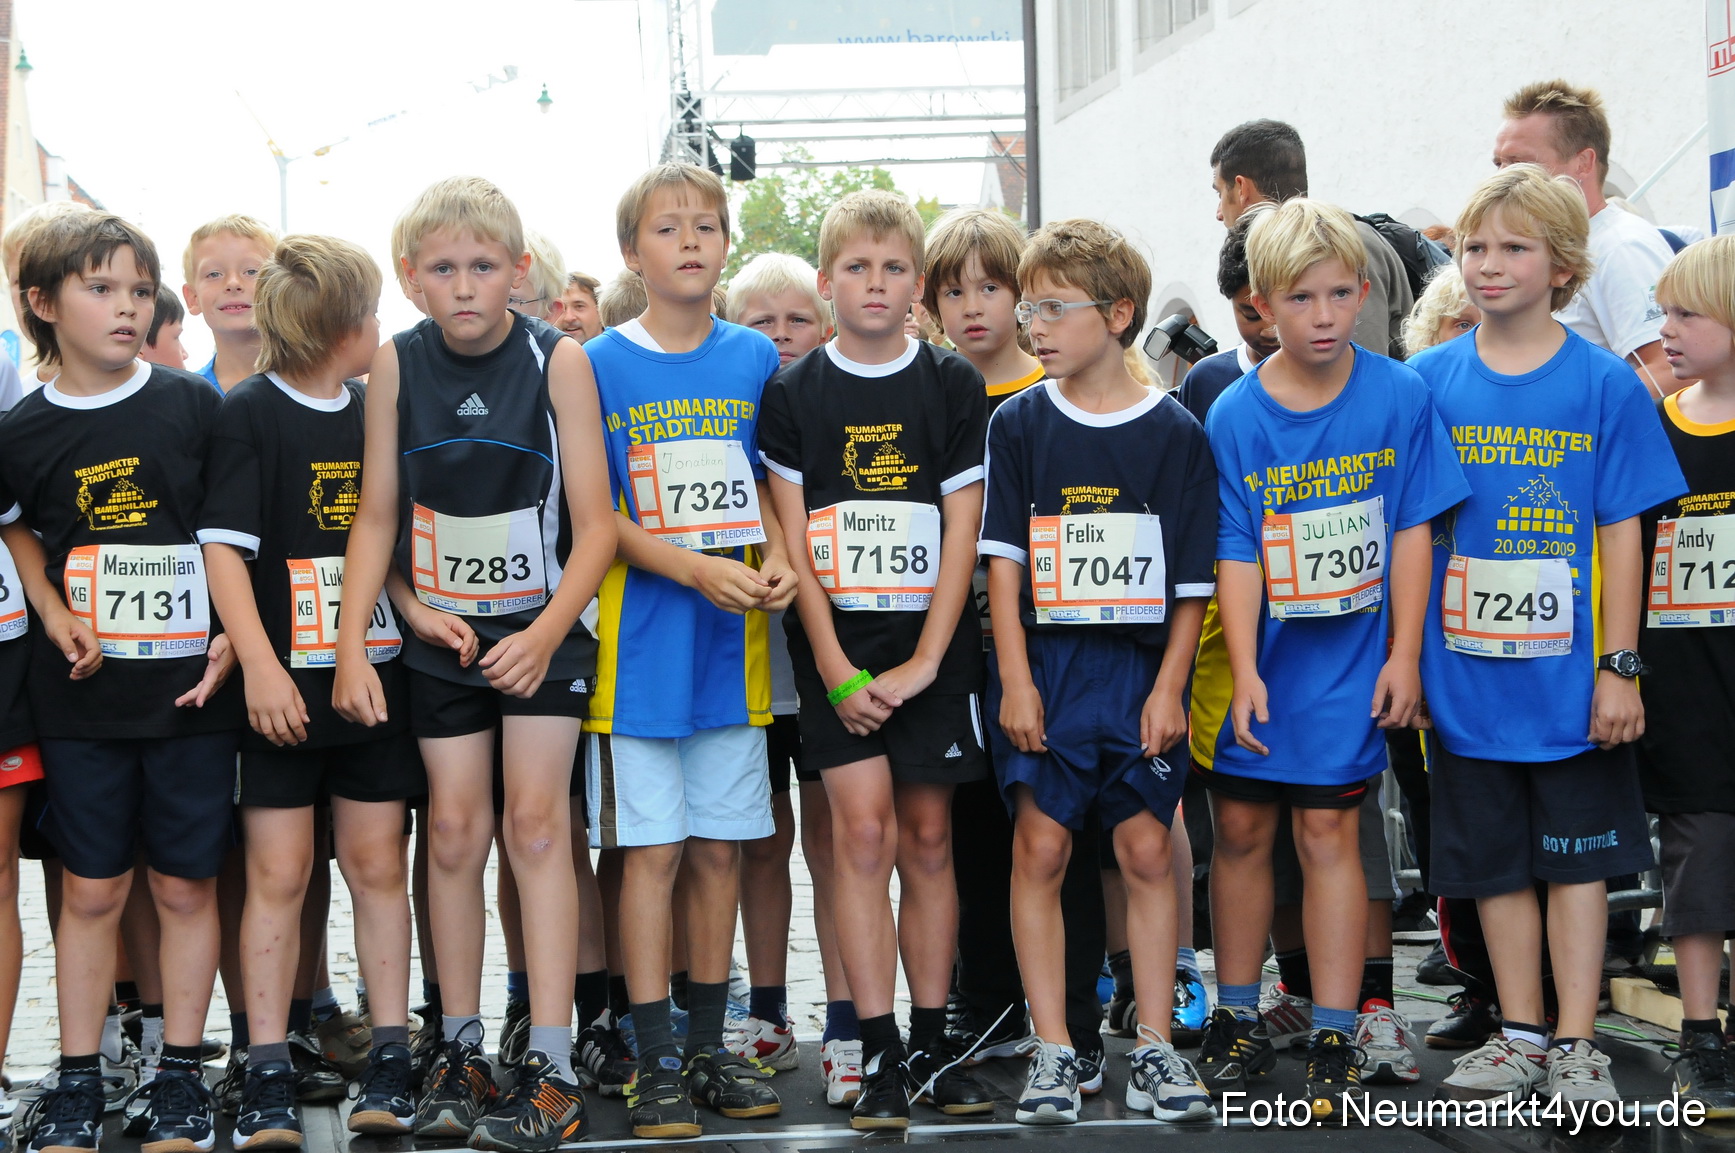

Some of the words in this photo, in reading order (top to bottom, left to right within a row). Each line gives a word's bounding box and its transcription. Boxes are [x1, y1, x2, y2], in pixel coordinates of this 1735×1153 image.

[457, 406, 489, 416] adidas
[605, 412, 627, 433] 10.
[629, 398, 756, 426] NEUMARKTER
[628, 418, 738, 446] STADTLAUF
[845, 424, 903, 434] NEUMARKTER
[849, 432, 898, 443] STADTLAUF
[1451, 426, 1593, 452] NEUMARKTER
[311, 461, 361, 471] NEUMARKTER
[661, 453, 723, 474] Jonathan
[1455, 446, 1565, 468] TADTLAUF
[74, 457, 140, 478] NEUMARKTER
[81, 467, 135, 486] STADTLAUF
[316, 470, 358, 480] STADTLAUF
[858, 465, 919, 476] BAMBINILAUF
[1266, 448, 1396, 486] NEUMARKTER
[667, 480, 748, 514] 7325
[1061, 486, 1120, 497] NEUMARKTER
[1262, 472, 1374, 507] STADTLAUF
[1677, 491, 1735, 507] NEUMARKTER
[94, 500, 159, 515] BAMBINILAUF
[1066, 494, 1114, 505] STADTLAUF
[1681, 500, 1731, 513] STADTLAUF
[843, 511, 896, 532] Moritz
[1302, 513, 1372, 542] JULIAN
[716, 528, 763, 540] PFLEIDERER
[1066, 523, 1105, 544] Felix
[1677, 527, 1715, 551] Andy
[813, 545, 829, 560] K6
[1493, 538, 1577, 557] 20.09.2009
[103, 553, 196, 577] Maximilian
[444, 553, 531, 584] 7283
[847, 545, 929, 574] 7158
[1036, 556, 1052, 572] K6
[1304, 541, 1380, 582] 7302
[1655, 561, 1667, 576] K6
[1069, 556, 1153, 587] 7047
[70, 586, 87, 602] K6
[492, 594, 543, 608] PFLEIDERER
[105, 589, 192, 621] 7131
[297, 600, 313, 617] K6
[1115, 606, 1164, 615] PFLEIDERER
[1473, 591, 1559, 622] 7249
[154, 638, 206, 650] PFLEIDERER
[369, 646, 400, 656] PFLEIDERER
[1518, 639, 1570, 650] PFLEIDERER
[1543, 835, 1569, 854] BOY
[1574, 829, 1618, 854] ATTITUDE
